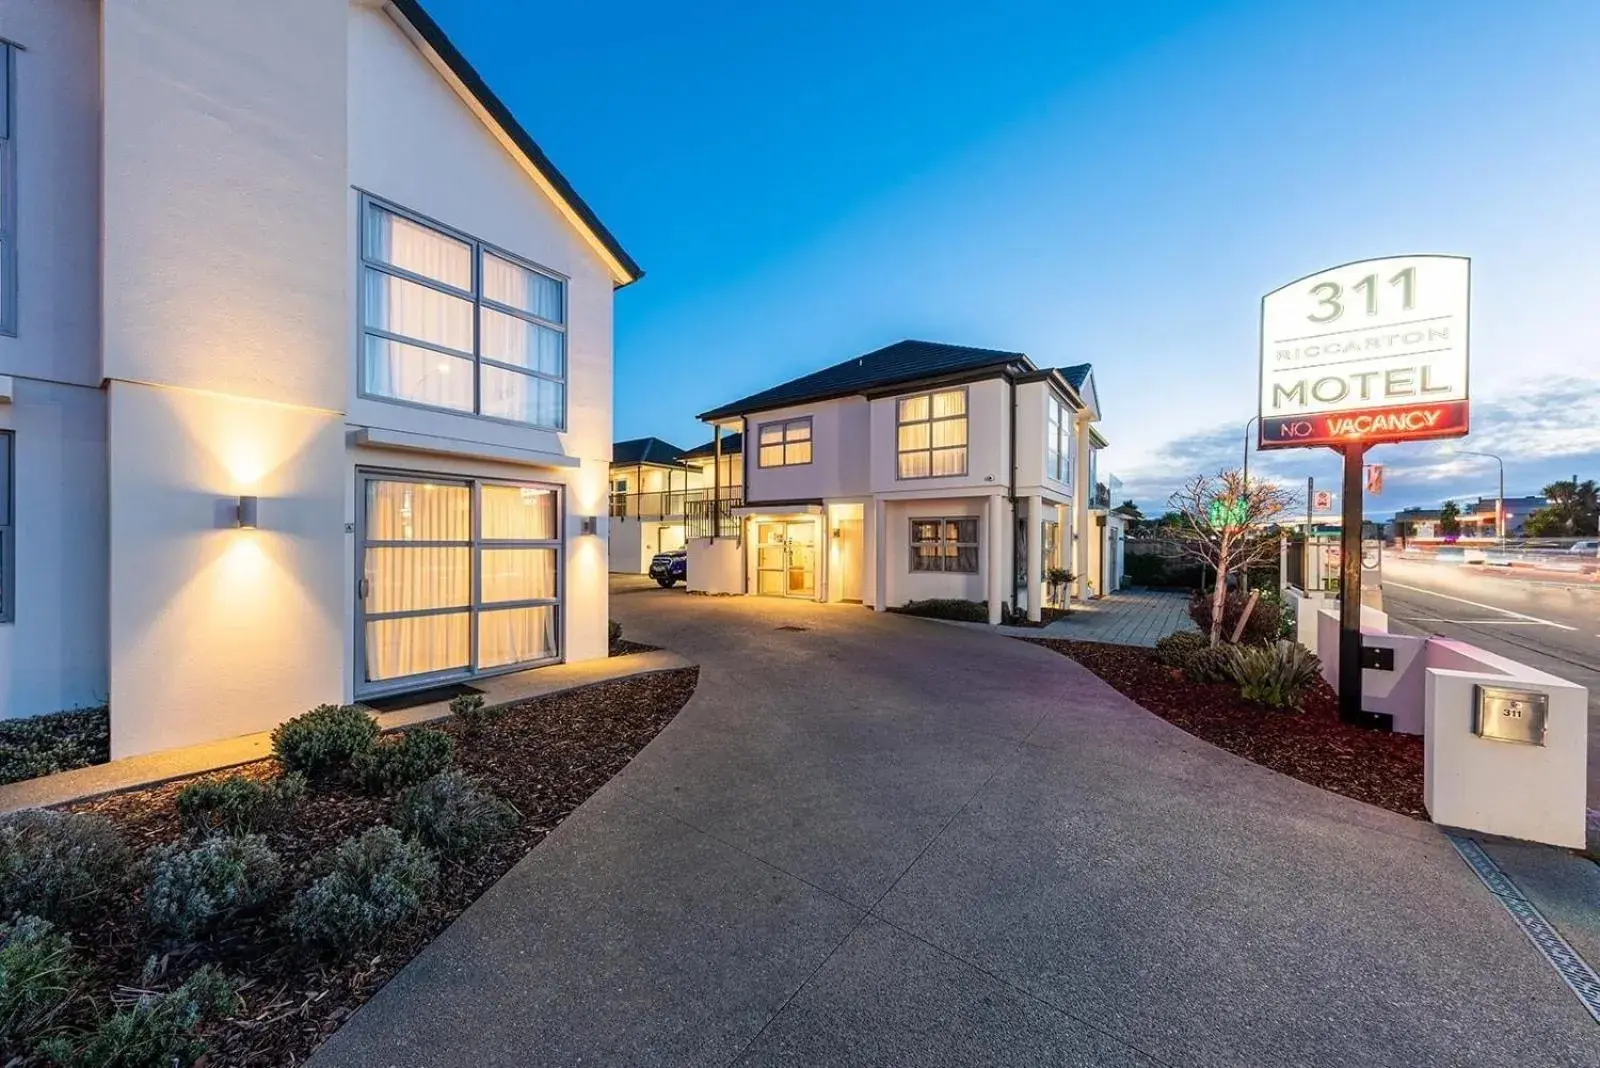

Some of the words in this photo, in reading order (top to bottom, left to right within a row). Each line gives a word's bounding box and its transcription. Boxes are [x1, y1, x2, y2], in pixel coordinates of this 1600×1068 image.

[1306, 266, 1417, 325] 311
[1275, 326, 1450, 361] RICCARTON
[1271, 364, 1453, 409] MOTEL
[1280, 421, 1313, 438] NO
[1326, 409, 1442, 436] VACANCY
[1503, 708, 1521, 718] 311
